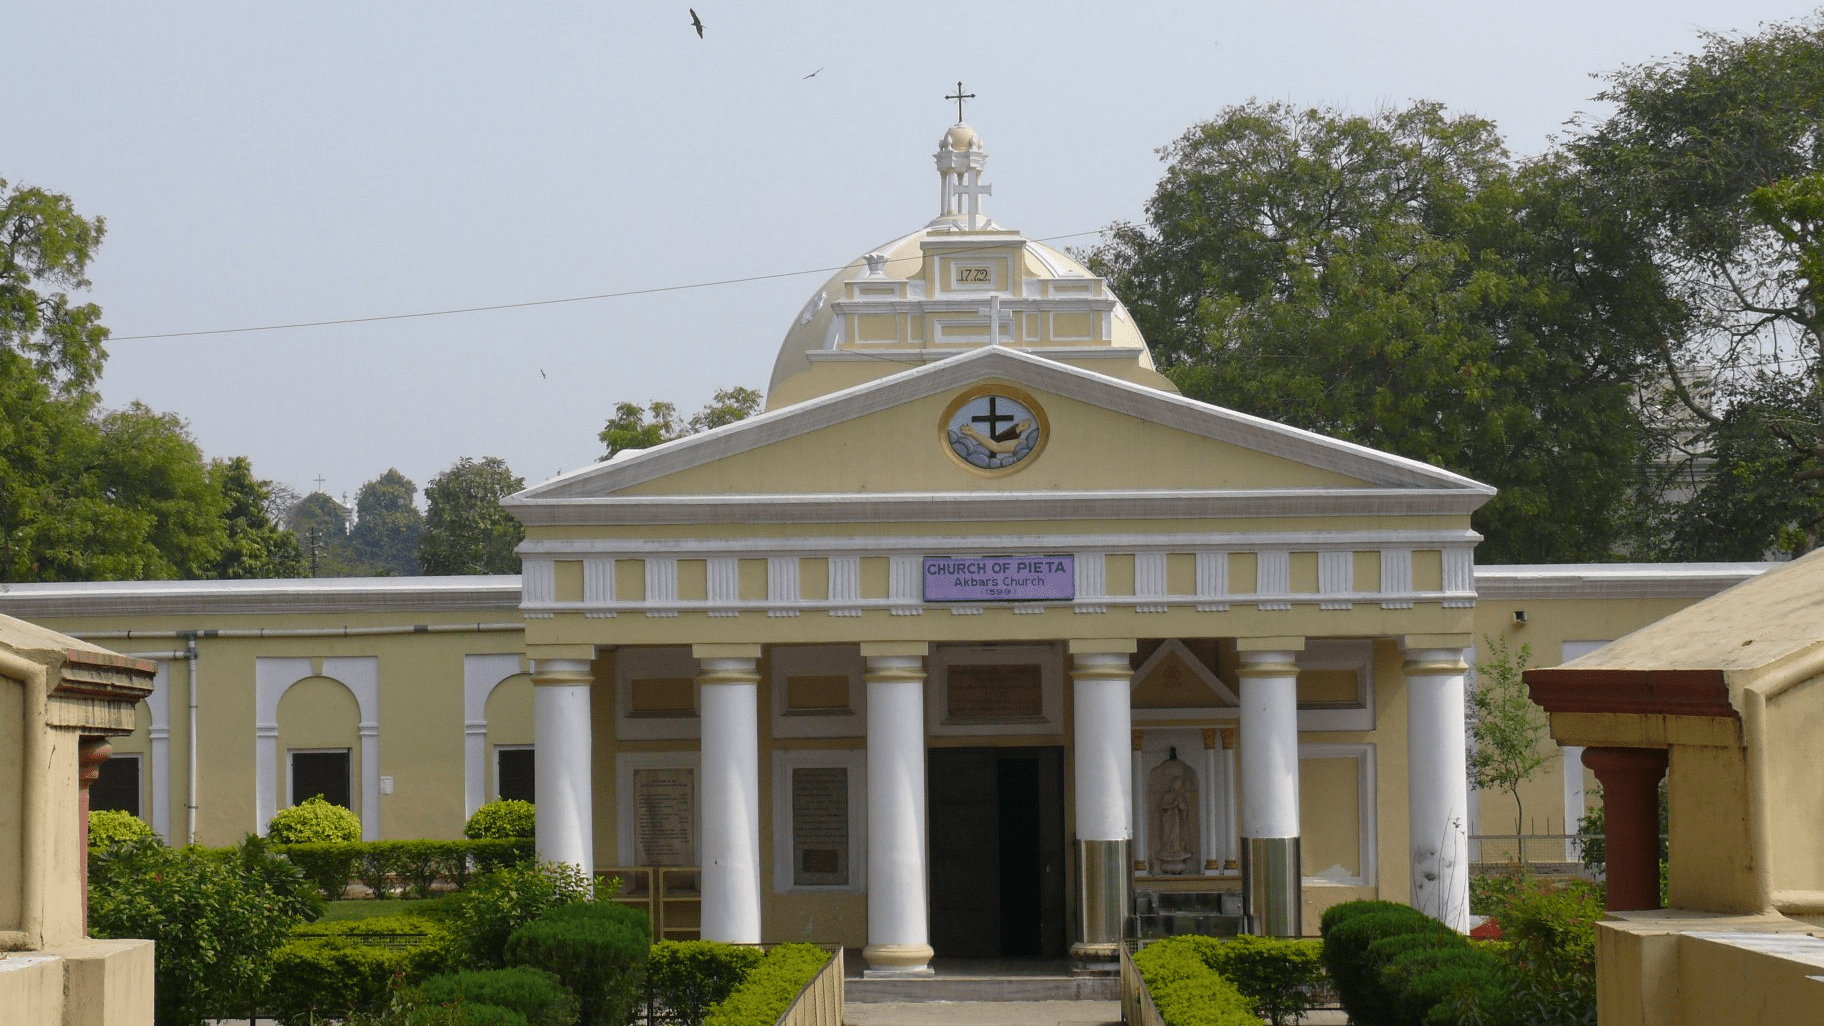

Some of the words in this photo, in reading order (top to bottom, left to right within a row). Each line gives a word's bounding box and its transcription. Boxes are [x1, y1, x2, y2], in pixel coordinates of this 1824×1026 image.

[927, 562, 987, 575] CHURCH
[991, 562, 1011, 574] OF
[1017, 561, 1066, 574] PIETA
[1002, 576, 1045, 587] Church
